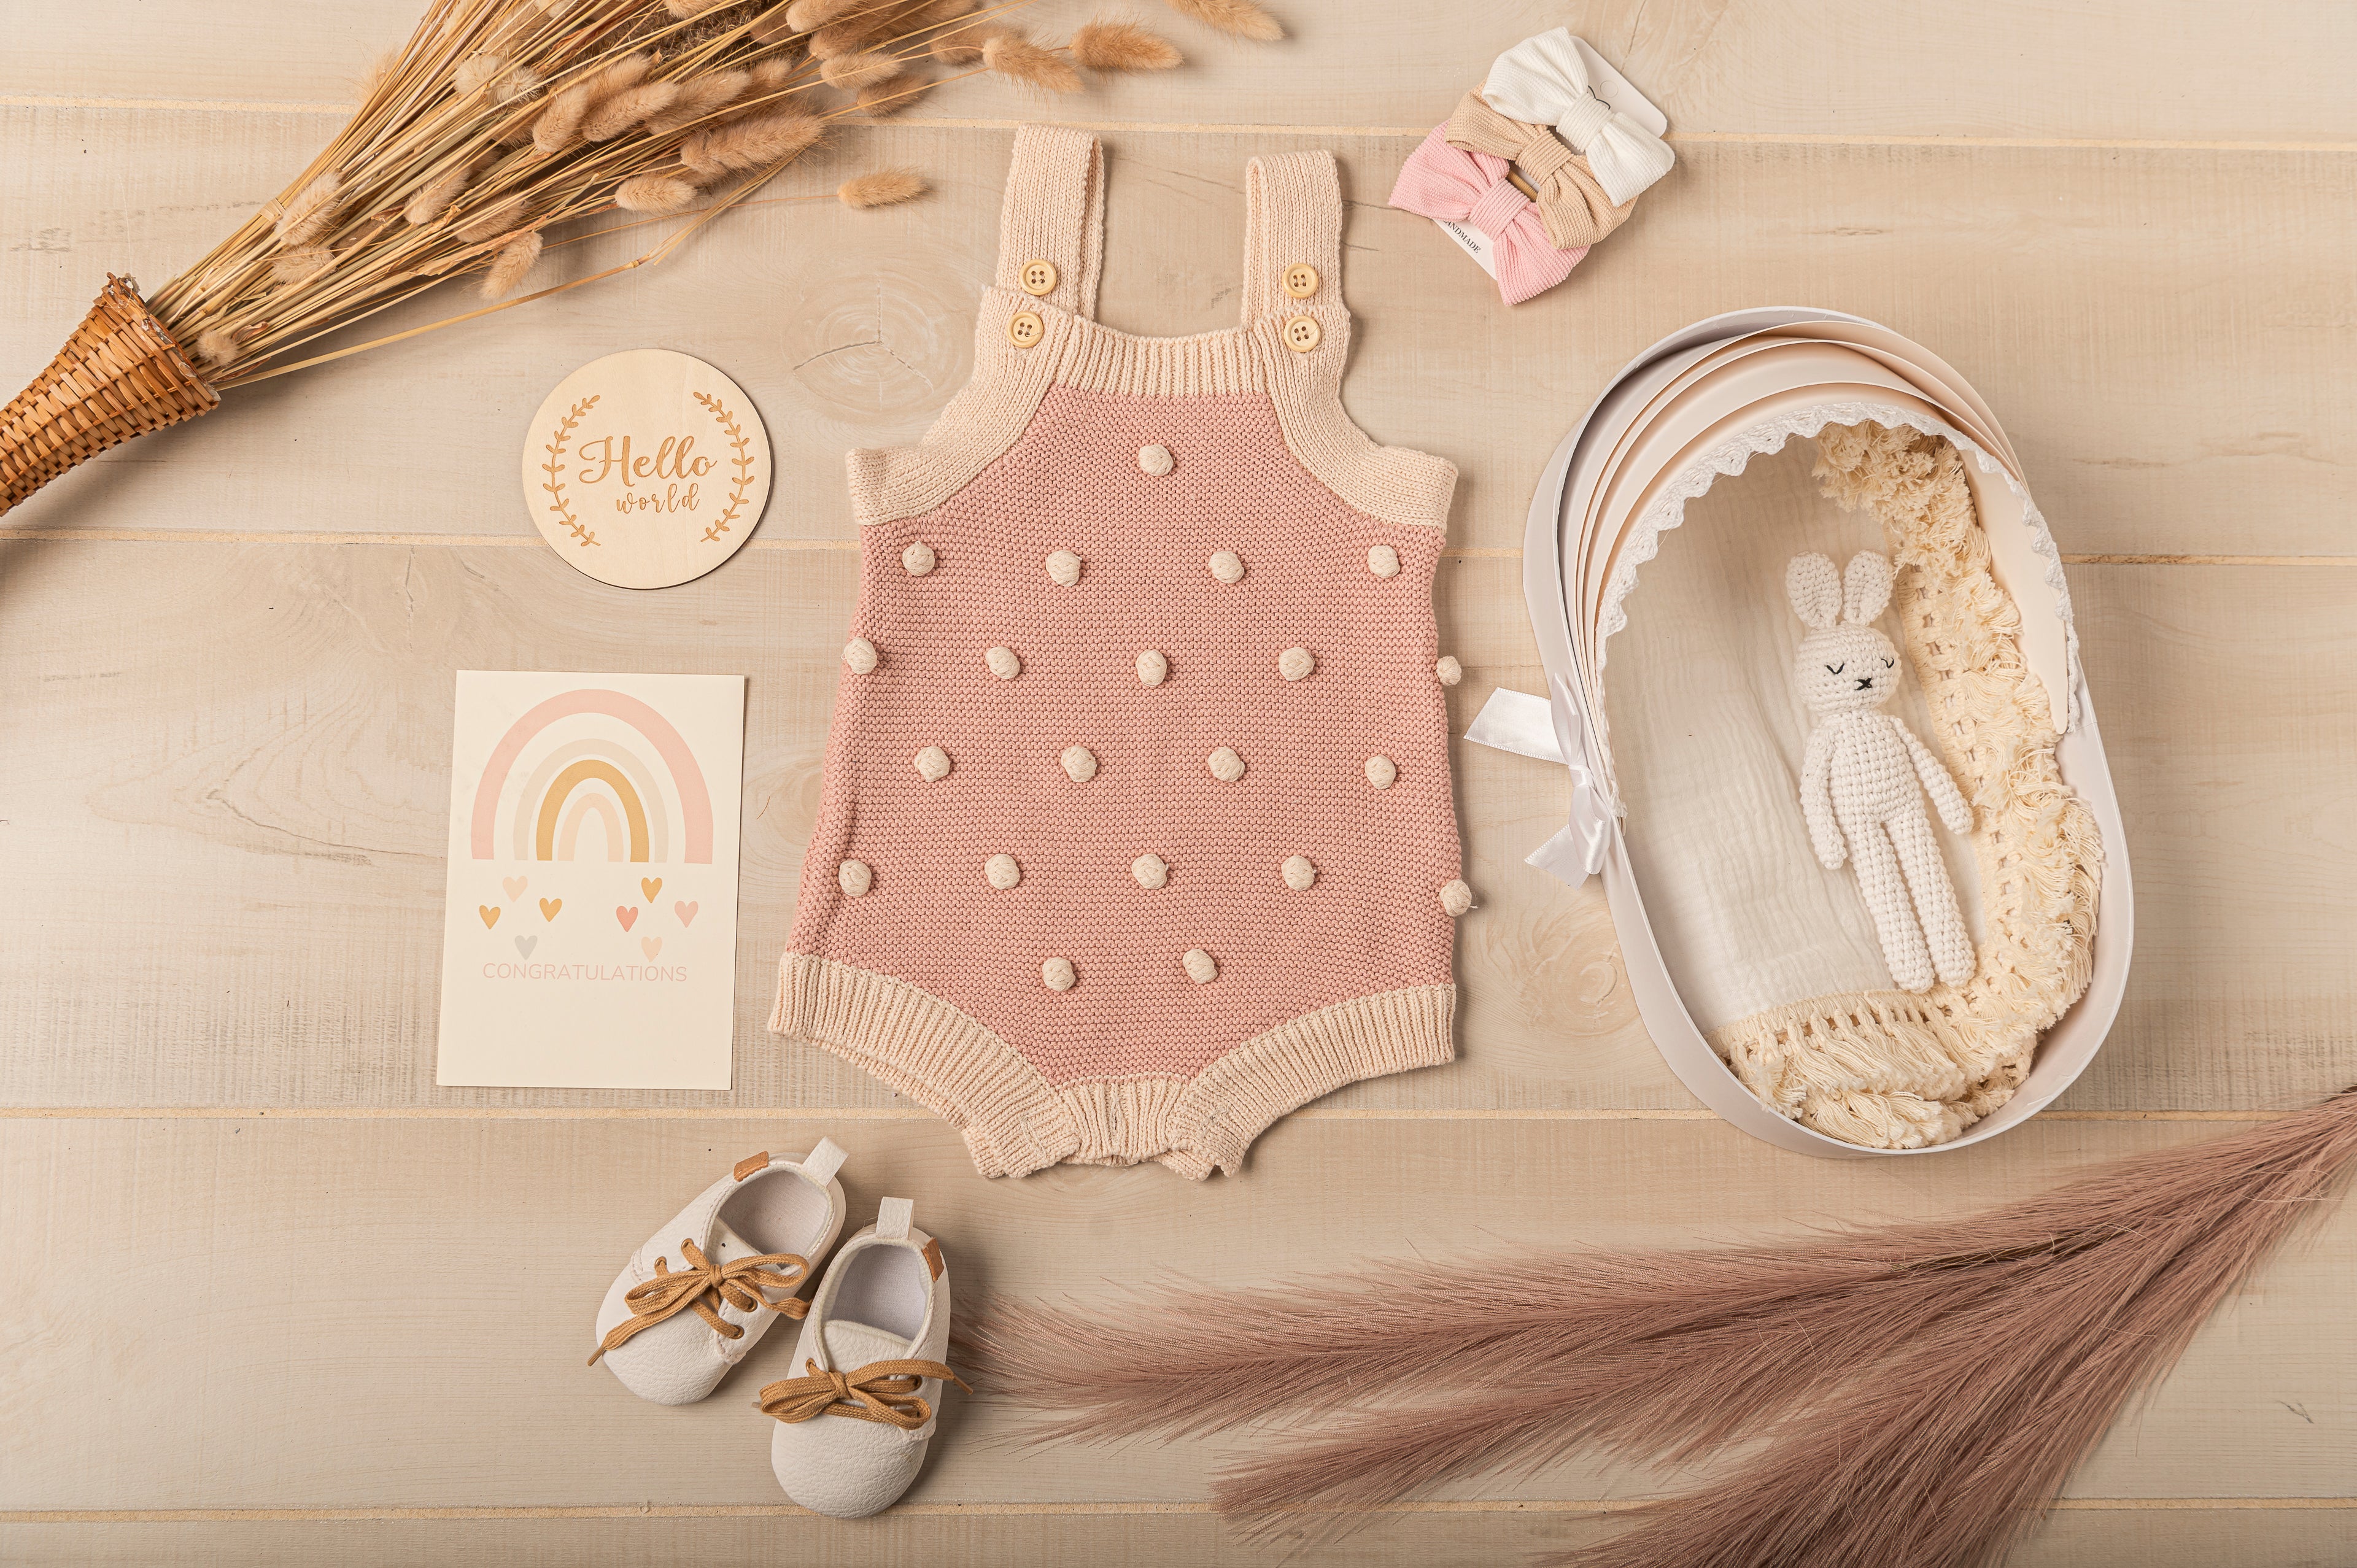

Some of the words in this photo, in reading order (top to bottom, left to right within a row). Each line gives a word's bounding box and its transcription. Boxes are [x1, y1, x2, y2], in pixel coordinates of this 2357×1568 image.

[579, 435, 718, 487] Hello
[616, 483, 700, 514] world
[482, 962, 687, 982] CONGRATULATIONS
